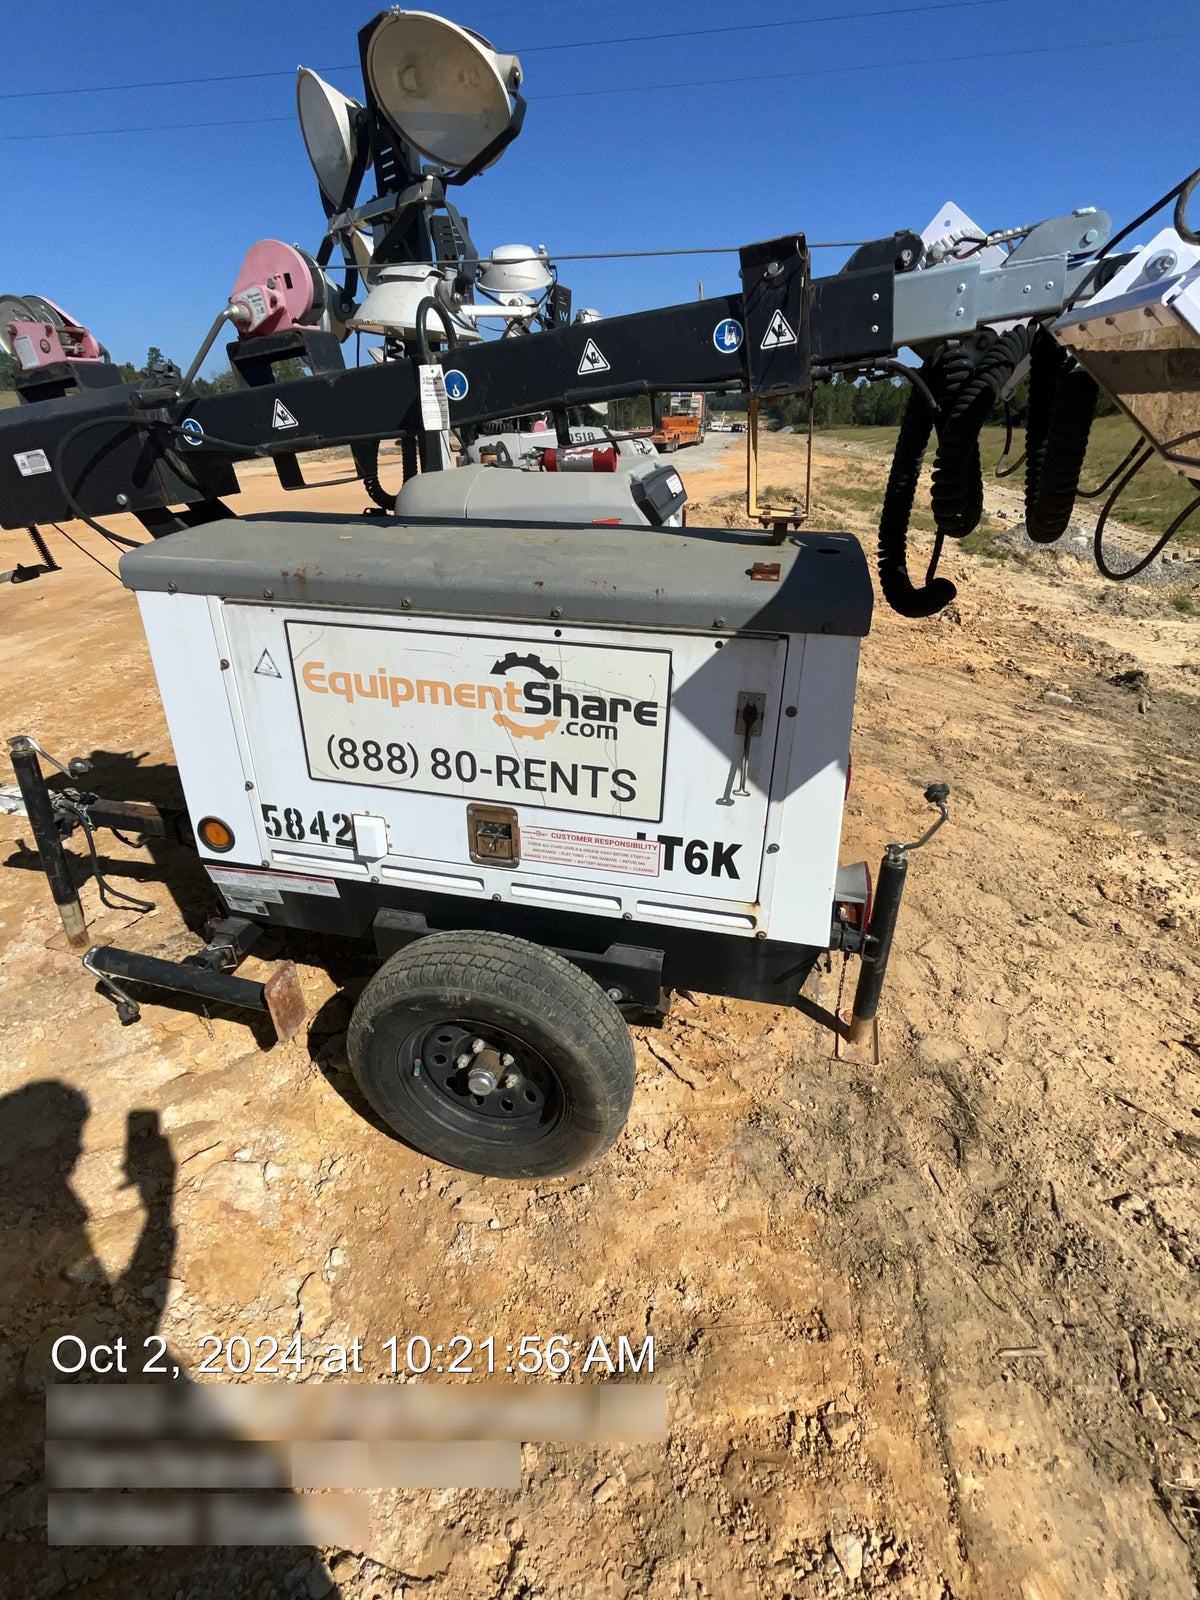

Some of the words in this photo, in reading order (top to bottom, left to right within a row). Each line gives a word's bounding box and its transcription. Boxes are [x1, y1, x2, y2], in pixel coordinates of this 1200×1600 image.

[302, 661, 658, 727] EquipmentShare
[561, 721, 618, 740] .com
[327, 734, 419, 778] (888)
[430, 748, 637, 802] 80-RENTS
[261, 803, 355, 847] 5842
[551, 832, 593, 843] CUSTOMER
[595, 838, 658, 851] RESPONSIBILITY
[637, 832, 743, 880] T6K
